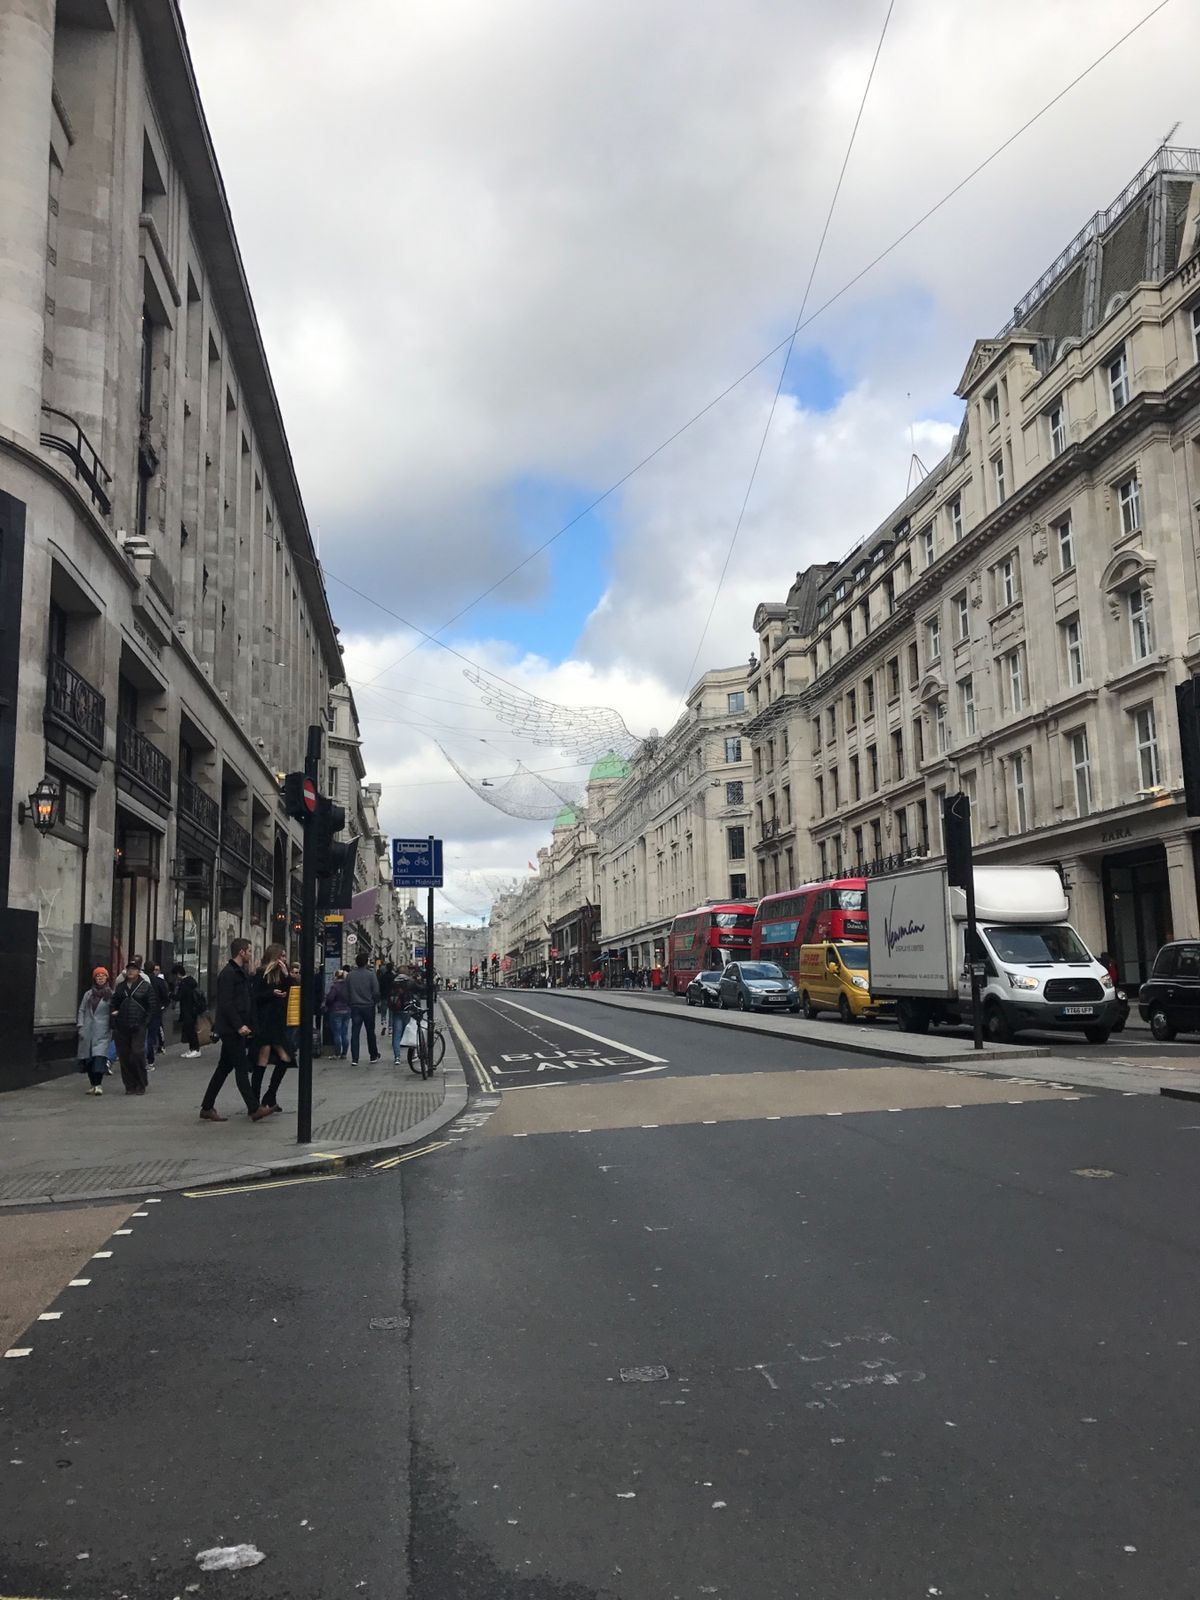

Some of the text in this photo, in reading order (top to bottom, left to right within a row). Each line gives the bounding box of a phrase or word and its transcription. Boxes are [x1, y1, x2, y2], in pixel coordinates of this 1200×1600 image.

[1101, 827, 1132, 842] ZARA
[500, 1048, 601, 1062] BUS
[490, 1055, 643, 1075] LANE
